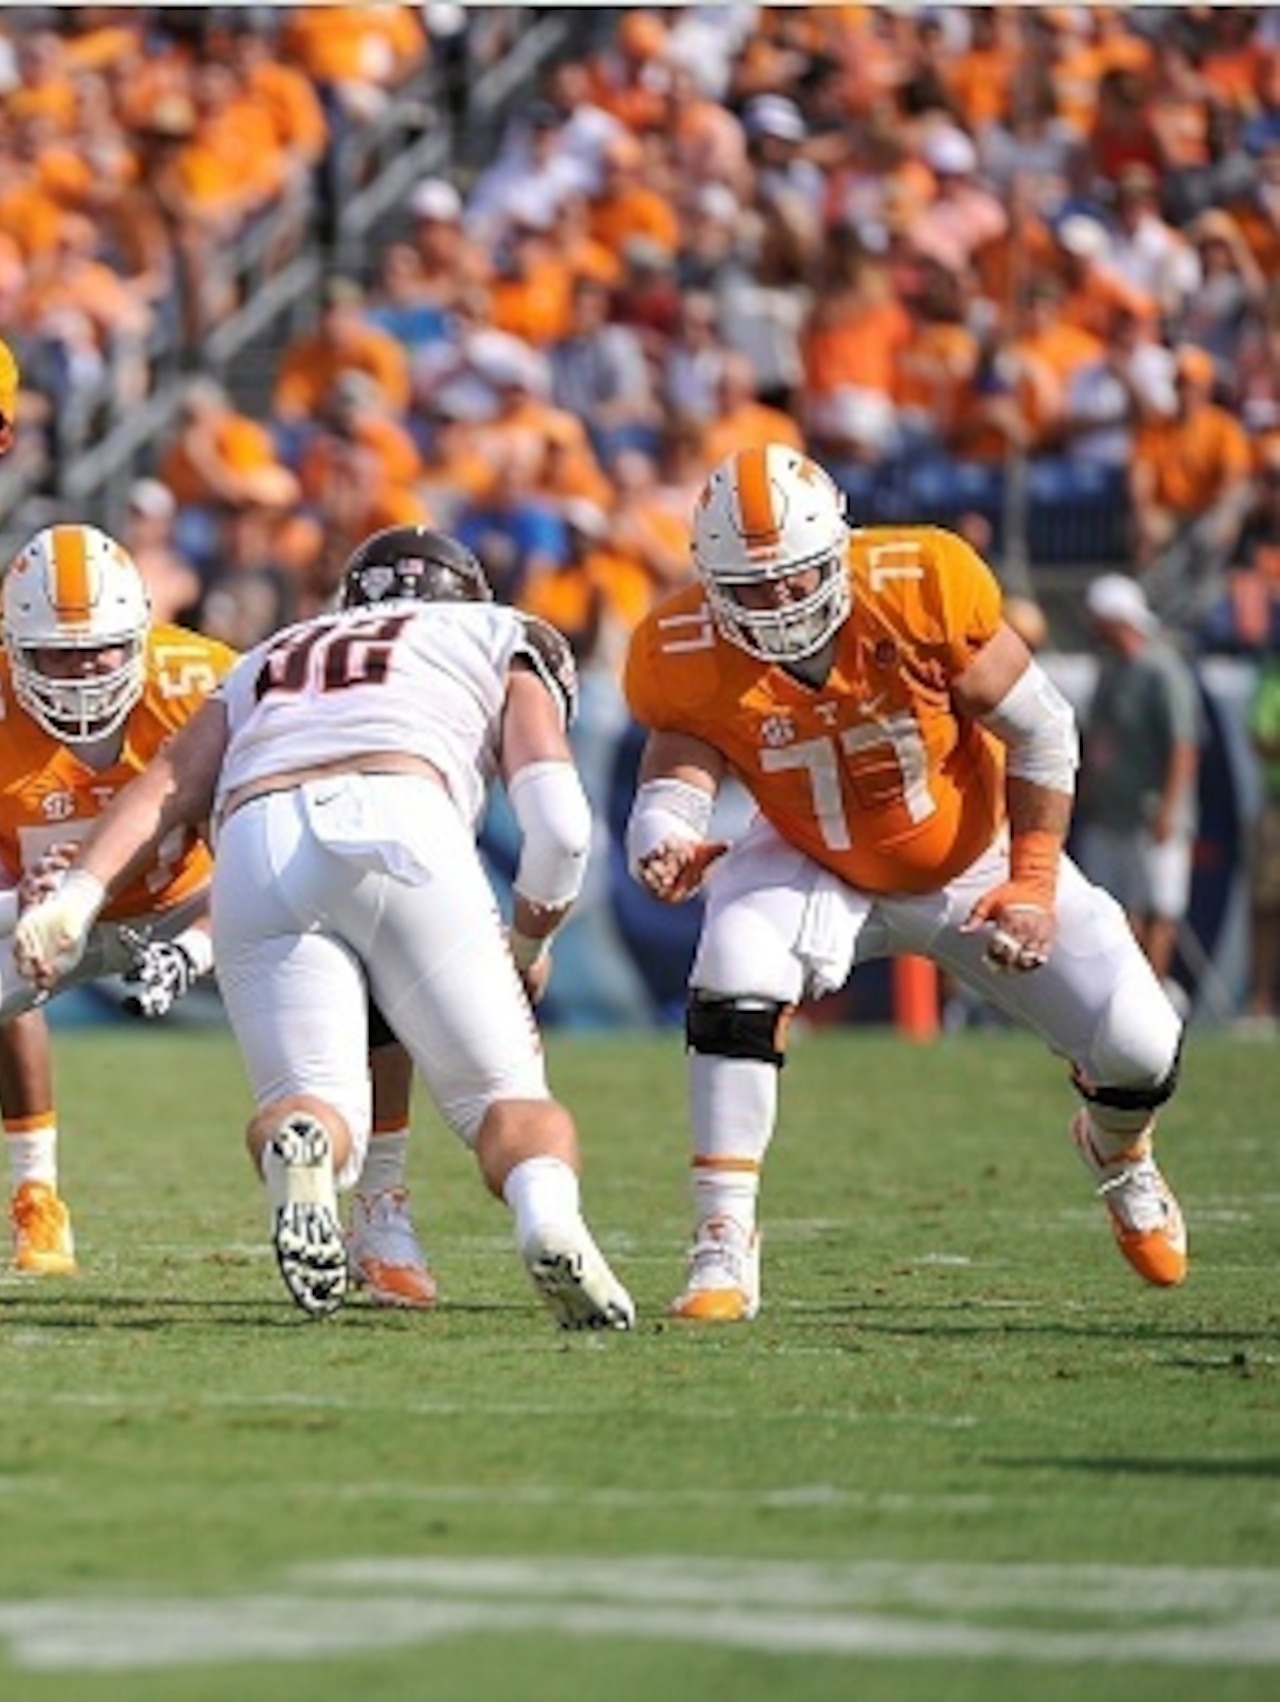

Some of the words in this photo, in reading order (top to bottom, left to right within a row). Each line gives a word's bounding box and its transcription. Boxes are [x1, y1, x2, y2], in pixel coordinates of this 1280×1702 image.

[867, 541, 924, 593] 77
[658, 601, 715, 653] 77
[154, 645, 217, 700] 57
[759, 715, 937, 850] 77
